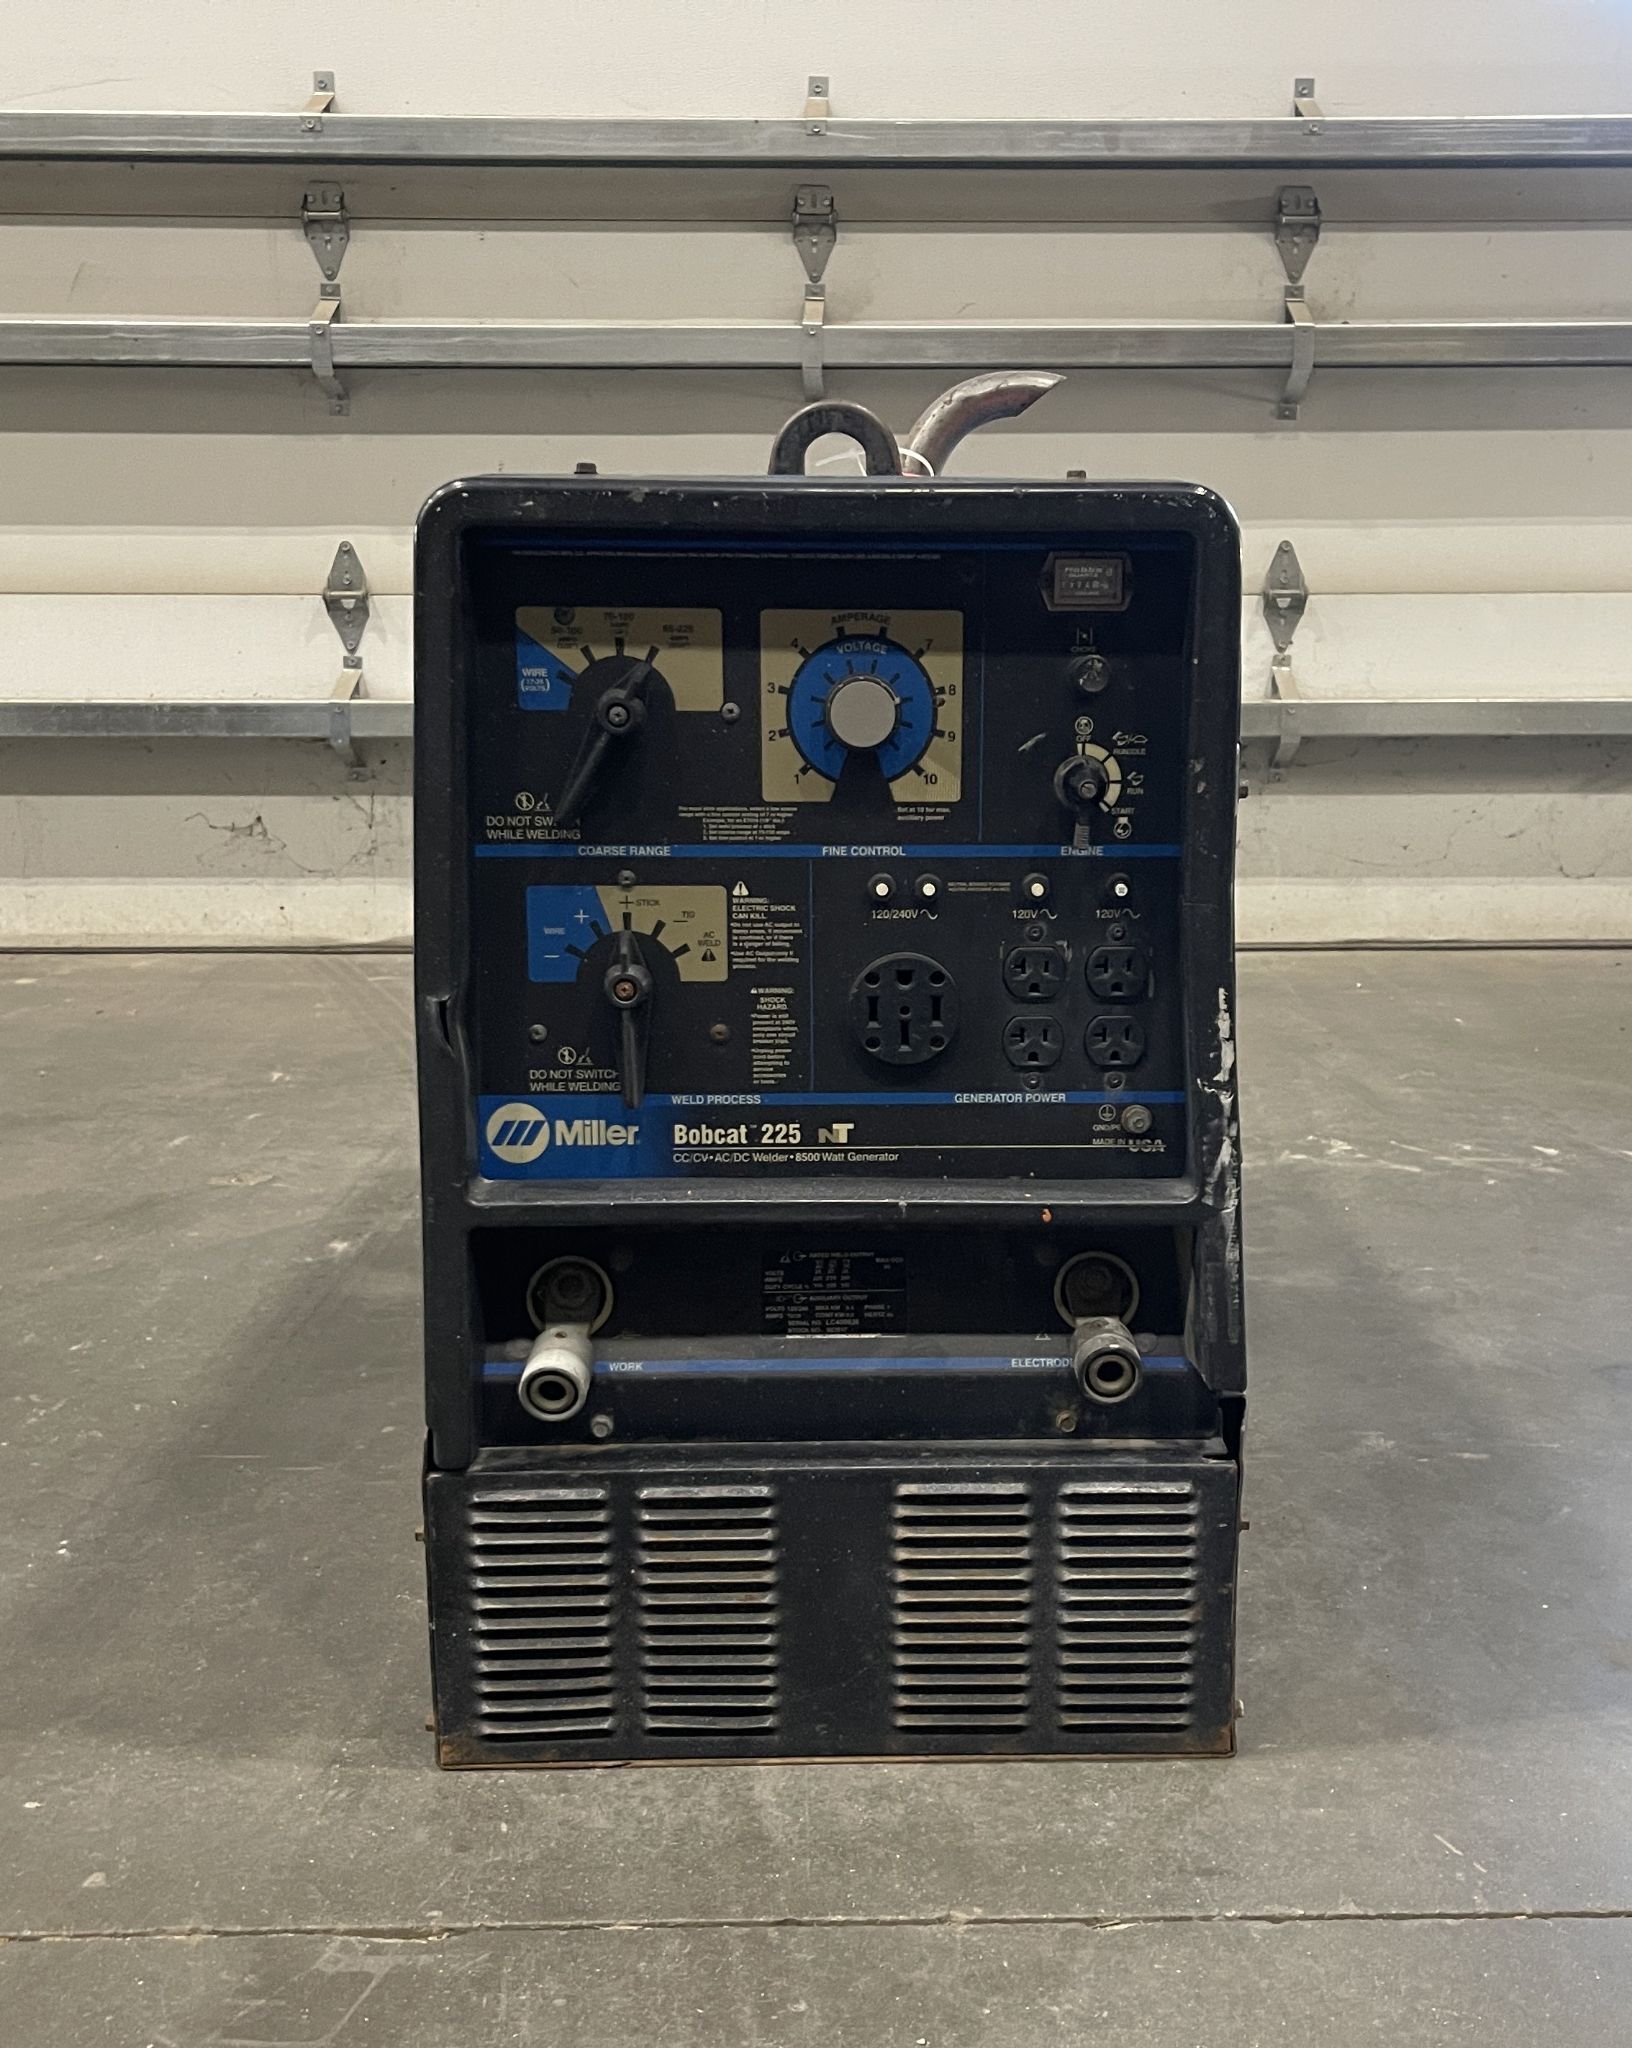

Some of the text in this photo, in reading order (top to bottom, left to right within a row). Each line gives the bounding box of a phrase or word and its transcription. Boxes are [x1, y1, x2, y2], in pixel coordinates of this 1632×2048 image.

[831, 613, 893, 625] AMPERAGE
[791, 638, 799, 649] 4
[836, 641, 888, 655] VOLTAGE
[924, 638, 933, 649] 7
[767, 682, 776, 694] 3
[948, 685, 956, 696] 8
[768, 730, 776, 741] 2
[948, 730, 956, 742] 9
[794, 774, 800, 784] 1
[923, 774, 938, 785] 10
[1111, 807, 1135, 815] START
[486, 816, 504, 827] DO
[507, 816, 532, 827] NOT
[486, 829, 581, 840] WHILE WELDING
[578, 846, 671, 856] COARSE RANGE
[822, 846, 906, 856] FINE CONTROL
[636, 899, 661, 907] STICK
[681, 910, 696, 919] TIG
[871, 909, 918, 919] 120/240V
[1012, 909, 1038, 919] 120V
[1096, 909, 1121, 919] 120V
[703, 931, 715, 939] AC
[697, 939, 721, 947] WELD
[529, 1069, 547, 1079] DO
[549, 1069, 573, 1079] NOT
[530, 1081, 621, 1091] WHILE WELDING
[671, 1095, 761, 1104] WELD PROCESS
[954, 1093, 1066, 1103] GENERATOR POWER
[555, 1119, 640, 1146] Miller
[761, 1123, 801, 1144] 225
[818, 1123, 855, 1144] NT
[1128, 1139, 1165, 1152] USA
[822, 1151, 845, 1162] Watt
[847, 1151, 899, 1162] Generator
[609, 1361, 644, 1372] WORK
